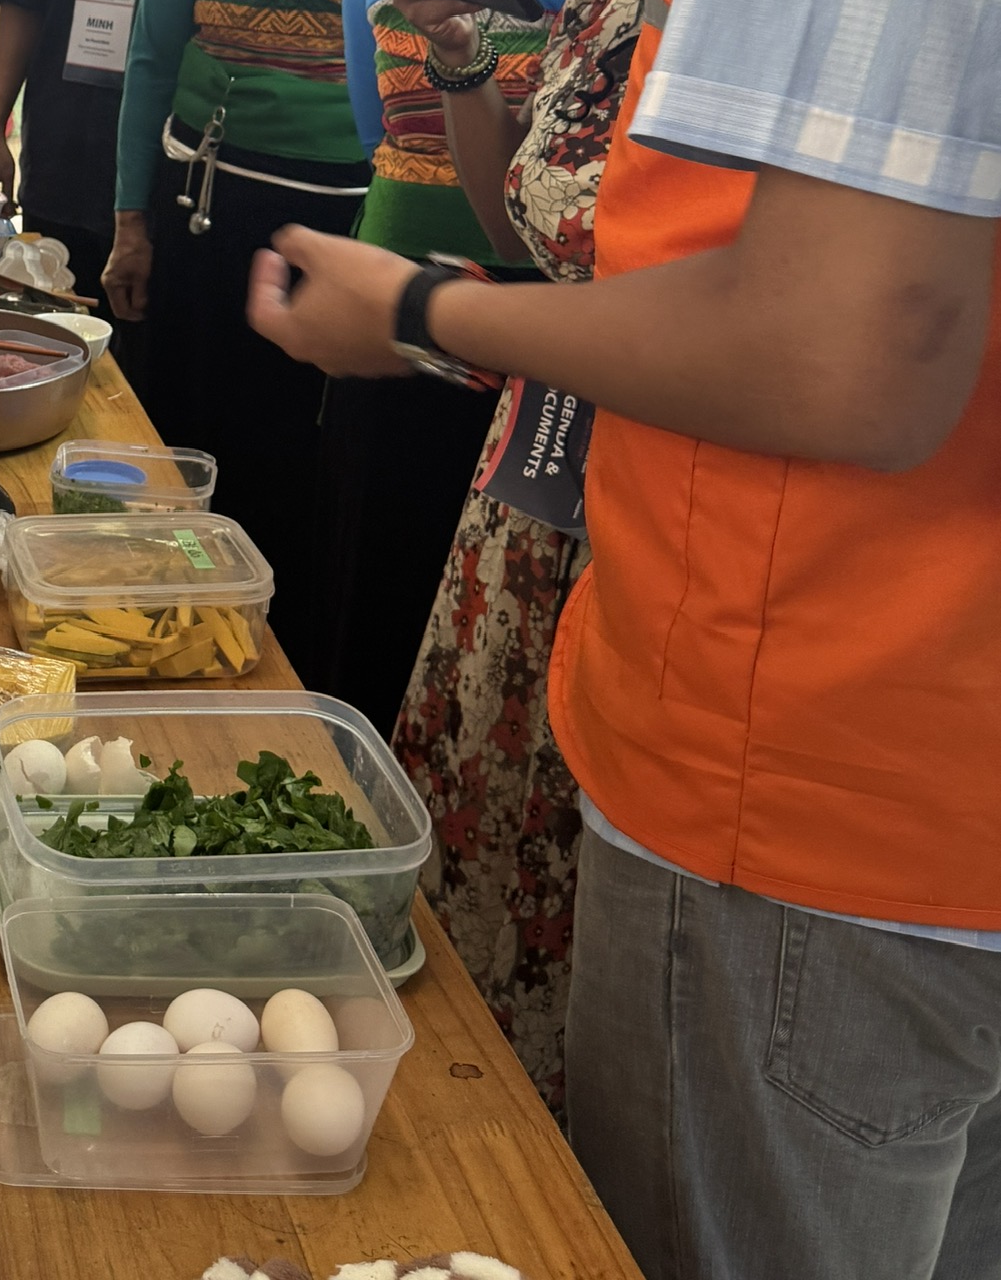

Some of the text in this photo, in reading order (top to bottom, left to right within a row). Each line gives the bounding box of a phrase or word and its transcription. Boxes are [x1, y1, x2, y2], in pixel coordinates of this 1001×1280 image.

[86, 16, 114, 30] MINH
[523, 387, 559, 480] CUMENTS
[545, 394, 578, 476] GENDA &
